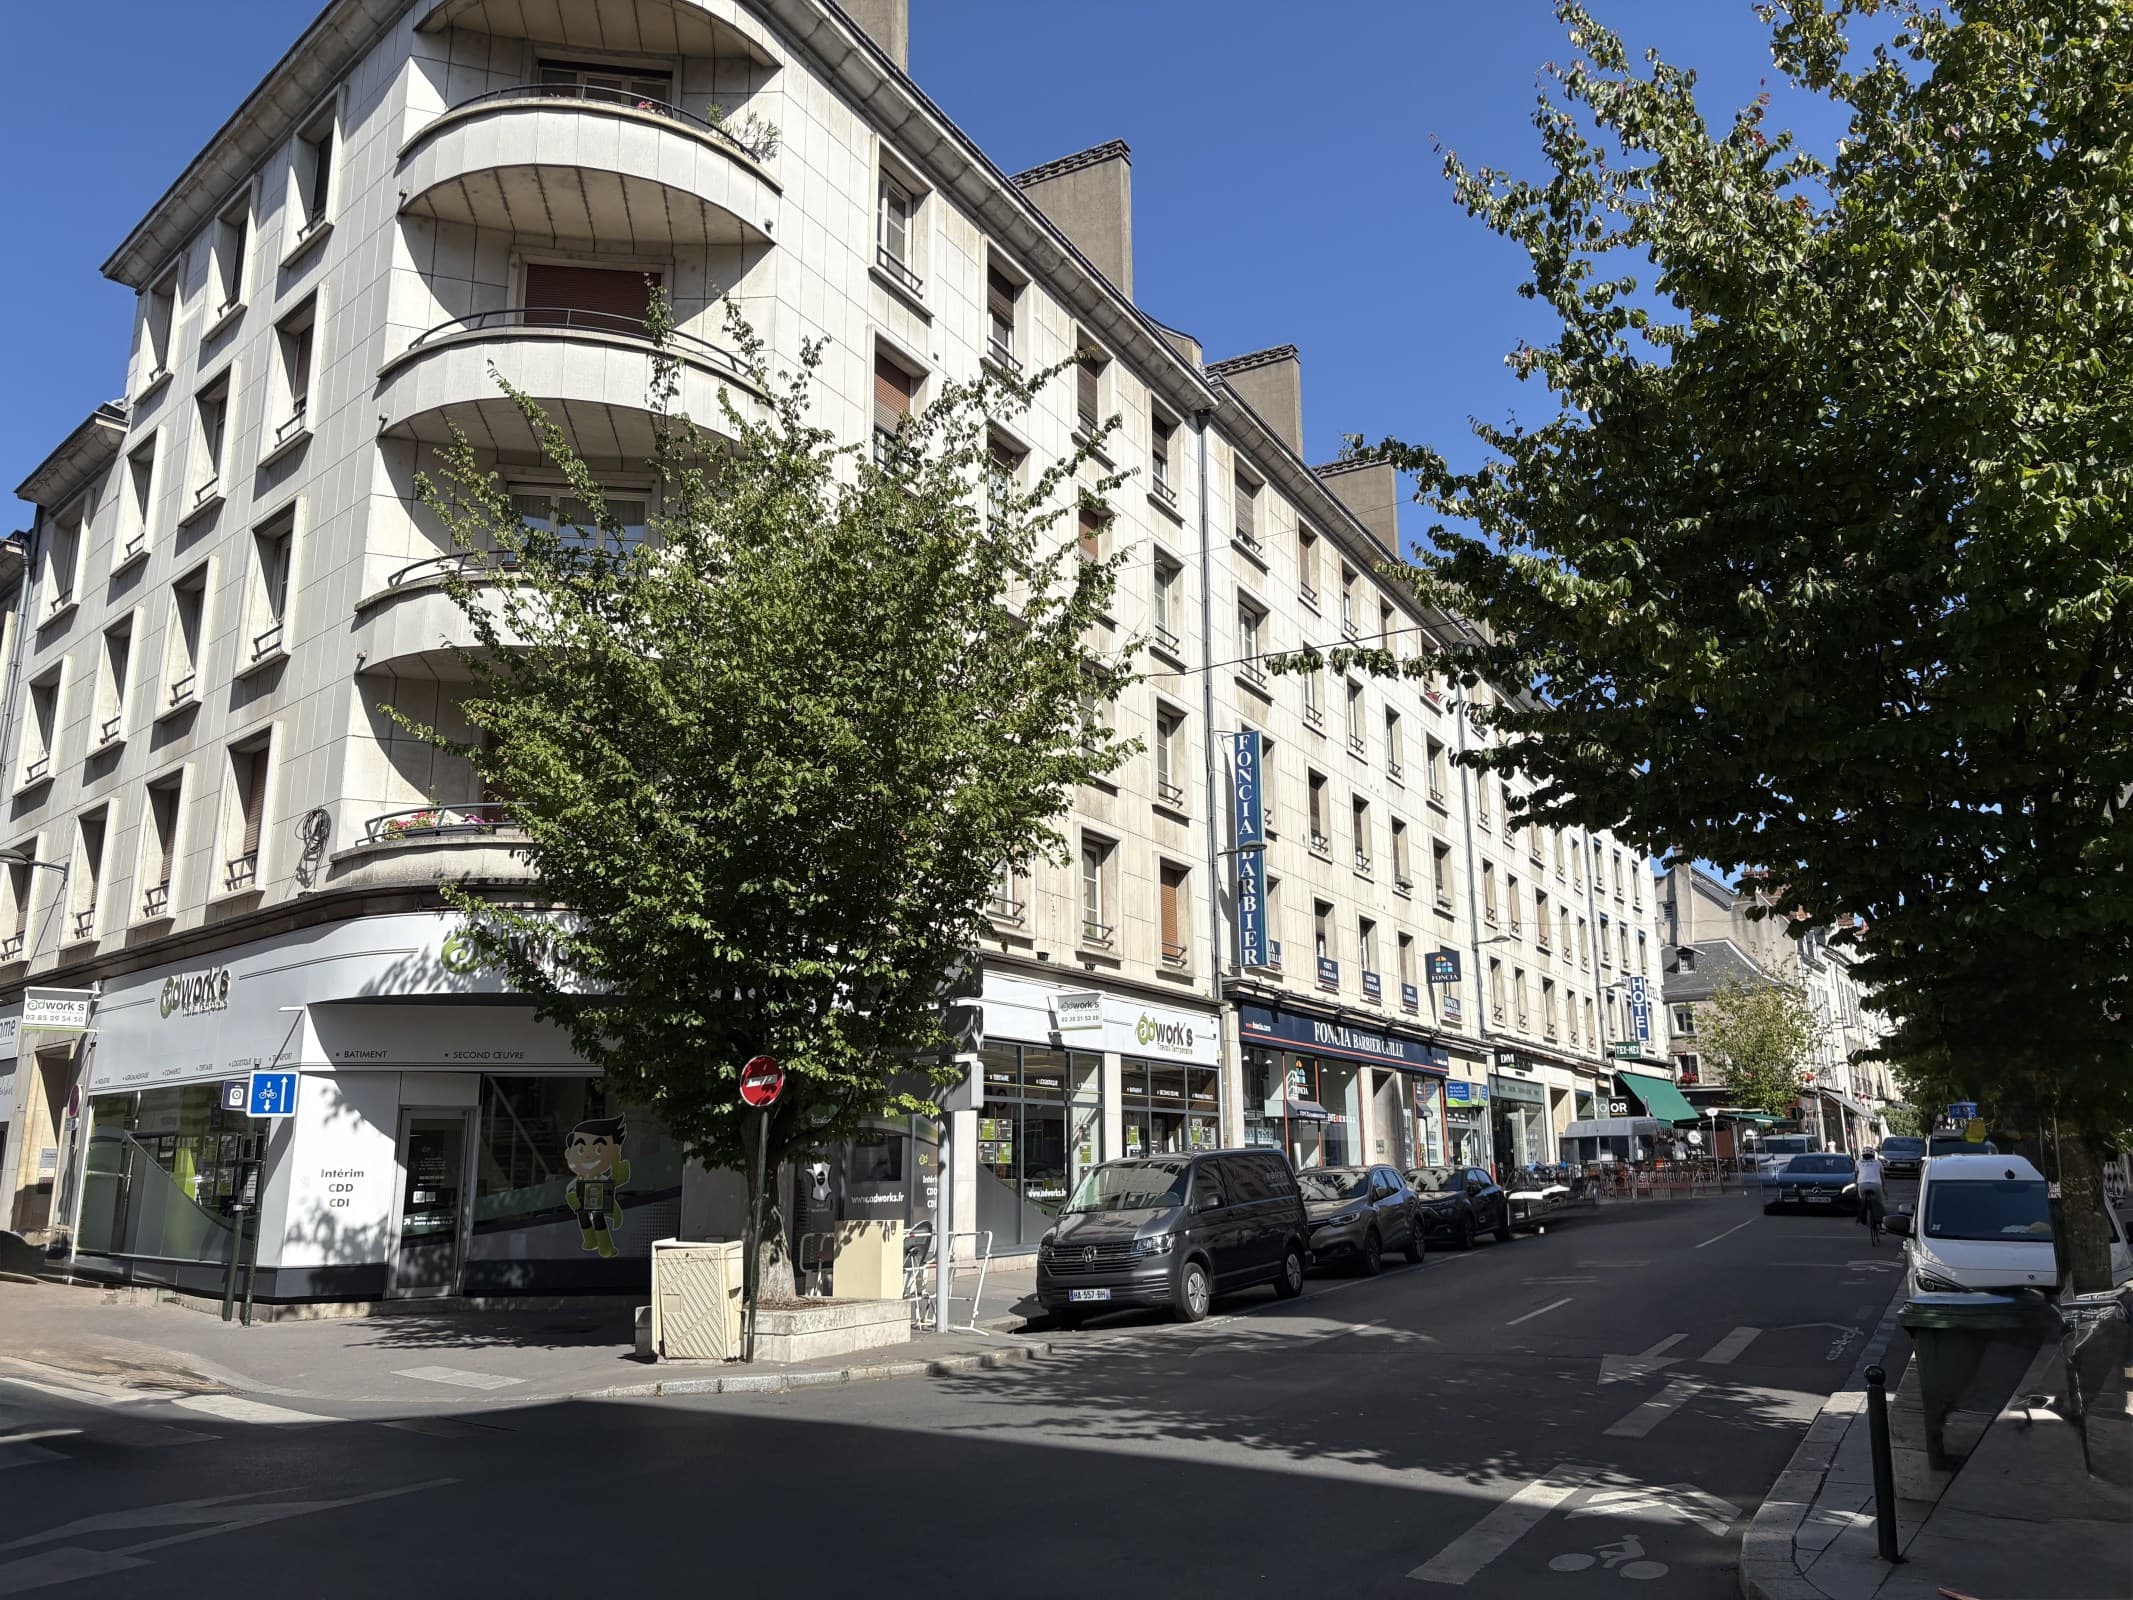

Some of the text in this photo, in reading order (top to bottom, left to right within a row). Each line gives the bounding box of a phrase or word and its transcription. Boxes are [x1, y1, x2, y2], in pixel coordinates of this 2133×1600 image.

[1236, 734, 1255, 835] FONCIA
[1632, 977, 1647, 1041] HOTEL
[1314, 1021, 1352, 1048] FONCIA
[1353, 1033, 1382, 1054] BARBIER
[343, 1050, 388, 1059] BATIMENT
[452, 1051, 490, 1059] SECOND
[1616, 1045, 1640, 1055] TEX-MEX
[1610, 1103, 1628, 1113] OR
[320, 1168, 365, 1178] Intérim
[328, 1183, 354, 1193] CDD
[329, 1198, 350, 1208] CDI
